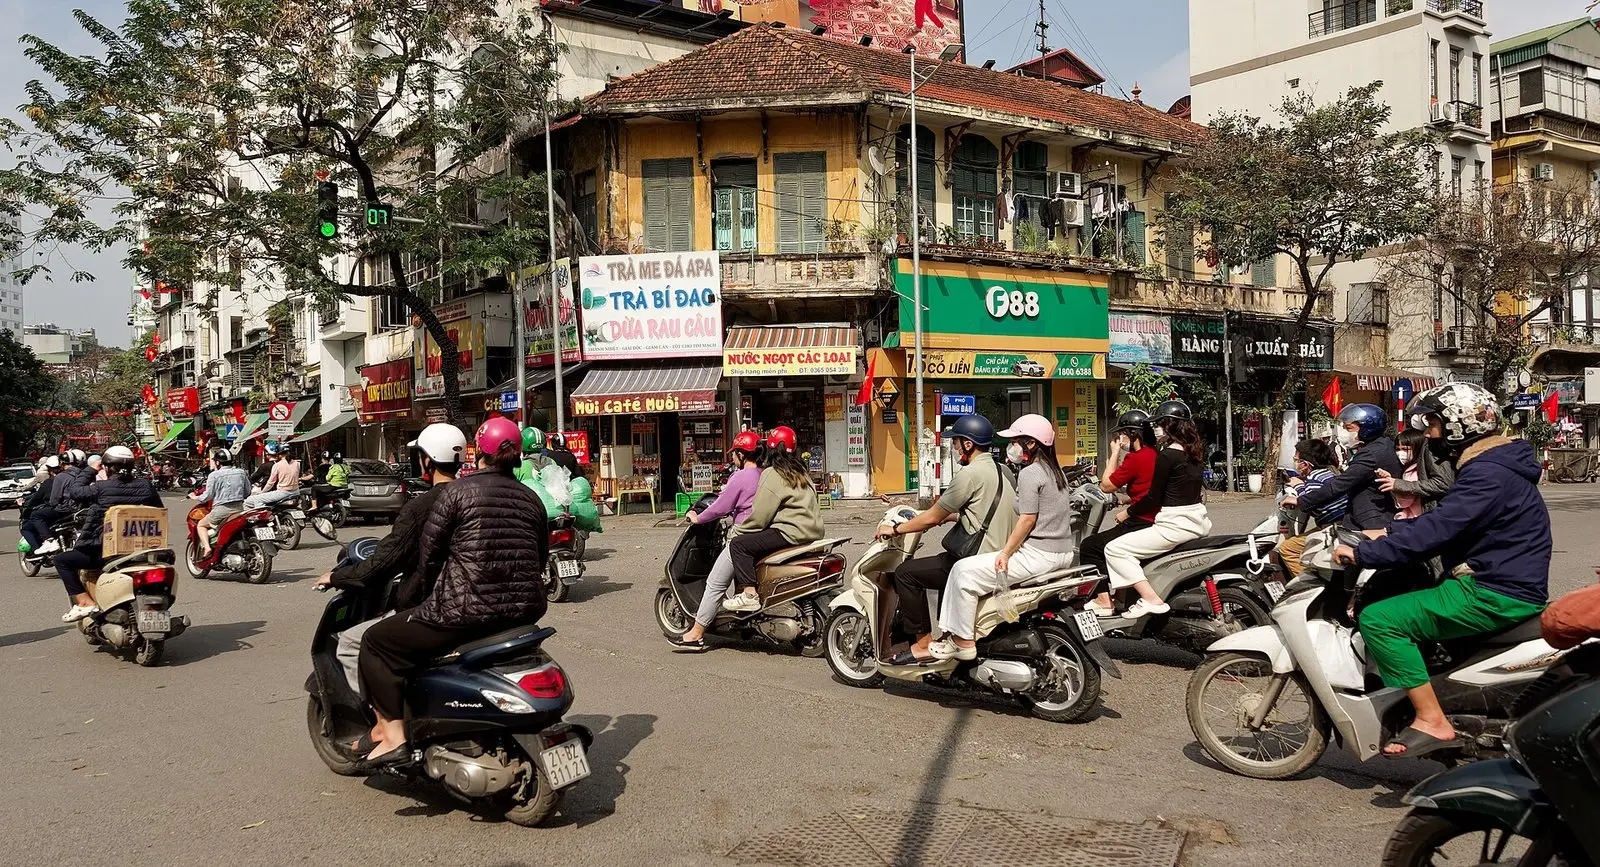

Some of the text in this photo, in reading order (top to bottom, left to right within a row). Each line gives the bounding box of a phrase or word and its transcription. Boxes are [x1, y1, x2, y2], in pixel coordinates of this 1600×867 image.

[368, 209, 387, 224] 07
[607, 255, 714, 281] TRÀ ME ĐÁ APA
[609, 285, 713, 310] TRÀ BÍ ĐAO
[986, 285, 1039, 317] F88
[610, 312, 716, 341] DỪA RAU CÂU
[1181, 335, 1219, 353] HÀNG
[1256, 336, 1289, 356] XUẤT
[728, 350, 851, 367] NƯỚC NGỌT CÁC LOẠI
[927, 357, 970, 374] CÓ LIỀN
[986, 356, 996, 364] CHỈ
[1058, 367, 1074, 376] 1800
[575, 393, 679, 415] Mùi Café Muối
[943, 403, 972, 413] HÀNG ĐẬU
[122, 520, 162, 537] JAVEL
[549, 743, 579, 768] 21-B2
[551, 758, 587, 786] 311.21
